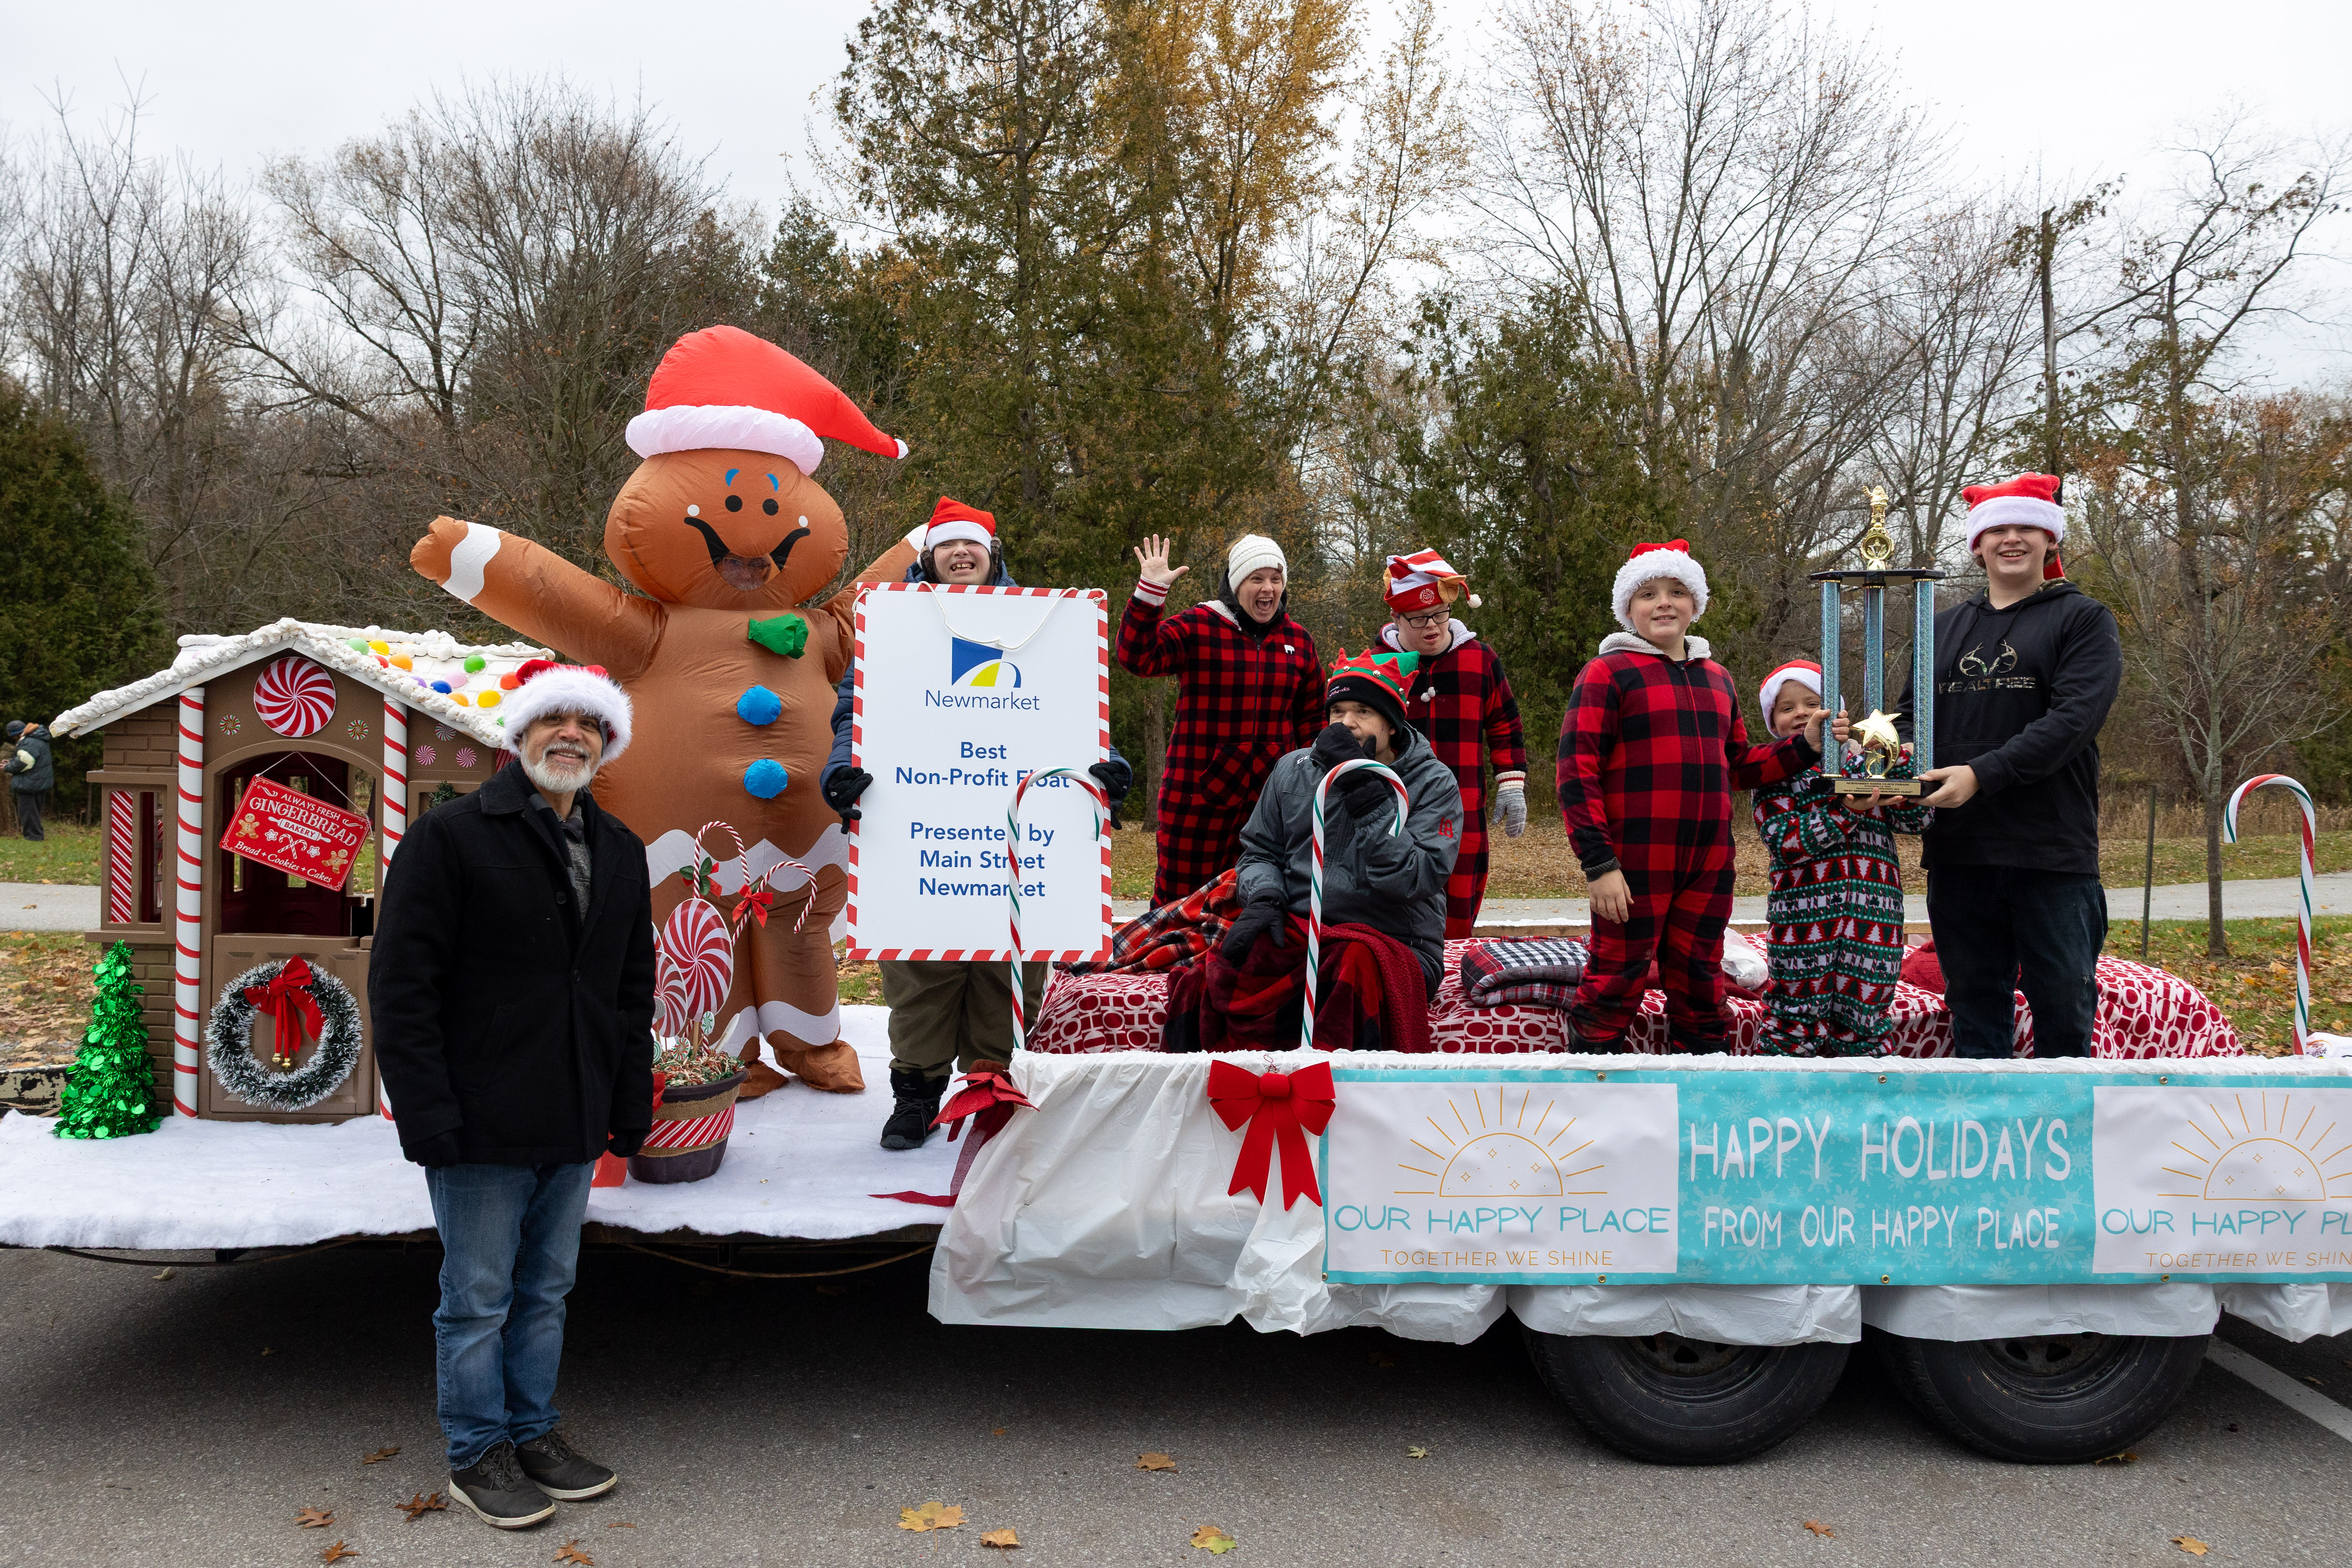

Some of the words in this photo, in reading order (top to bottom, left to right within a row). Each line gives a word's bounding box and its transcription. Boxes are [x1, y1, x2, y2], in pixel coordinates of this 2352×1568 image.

[1938, 676, 2036, 694] REALTREE
[926, 689, 1040, 710] Newmarket
[961, 741, 1007, 760] Best
[896, 767, 1008, 786] Non-Profit
[280, 793, 317, 811] ALWAYS
[317, 806, 341, 820] FRESH
[249, 797, 357, 846] GINGERBREAD
[284, 822, 315, 837] BAKERY
[1438, 816, 1453, 838] 18
[911, 822, 1020, 841] Presente
[1029, 823, 1054, 847] by
[234, 841, 261, 856] Bread
[267, 854, 300, 871] Cookies
[307, 868, 332, 884] Cakes
[920, 850, 972, 868] Main
[1691, 1116, 1830, 1182] HAPPY
[1862, 1116, 2071, 1181] HOLIDAYS
[1334, 1205, 1411, 1232] OUR
[1428, 1206, 1543, 1234] HAPPY
[1560, 1207, 1671, 1233] PLACE
[1705, 1206, 1782, 1249] FROM
[1800, 1205, 1855, 1247] OUR
[1872, 1205, 1959, 1249] HAPPY
[1977, 1207, 2060, 1249] PLACE
[2102, 1208, 2175, 1235] OUR
[2192, 1210, 2306, 1236] HAPPY
[1380, 1249, 1497, 1266] TOGETHER
[1505, 1250, 1539, 1266] WE
[1548, 1250, 1613, 1266] SHINE
[2145, 1252, 2258, 1268] TOGETHER
[2266, 1251, 2297, 1266] WE
[2305, 1251, 2352, 1266] SHIN
